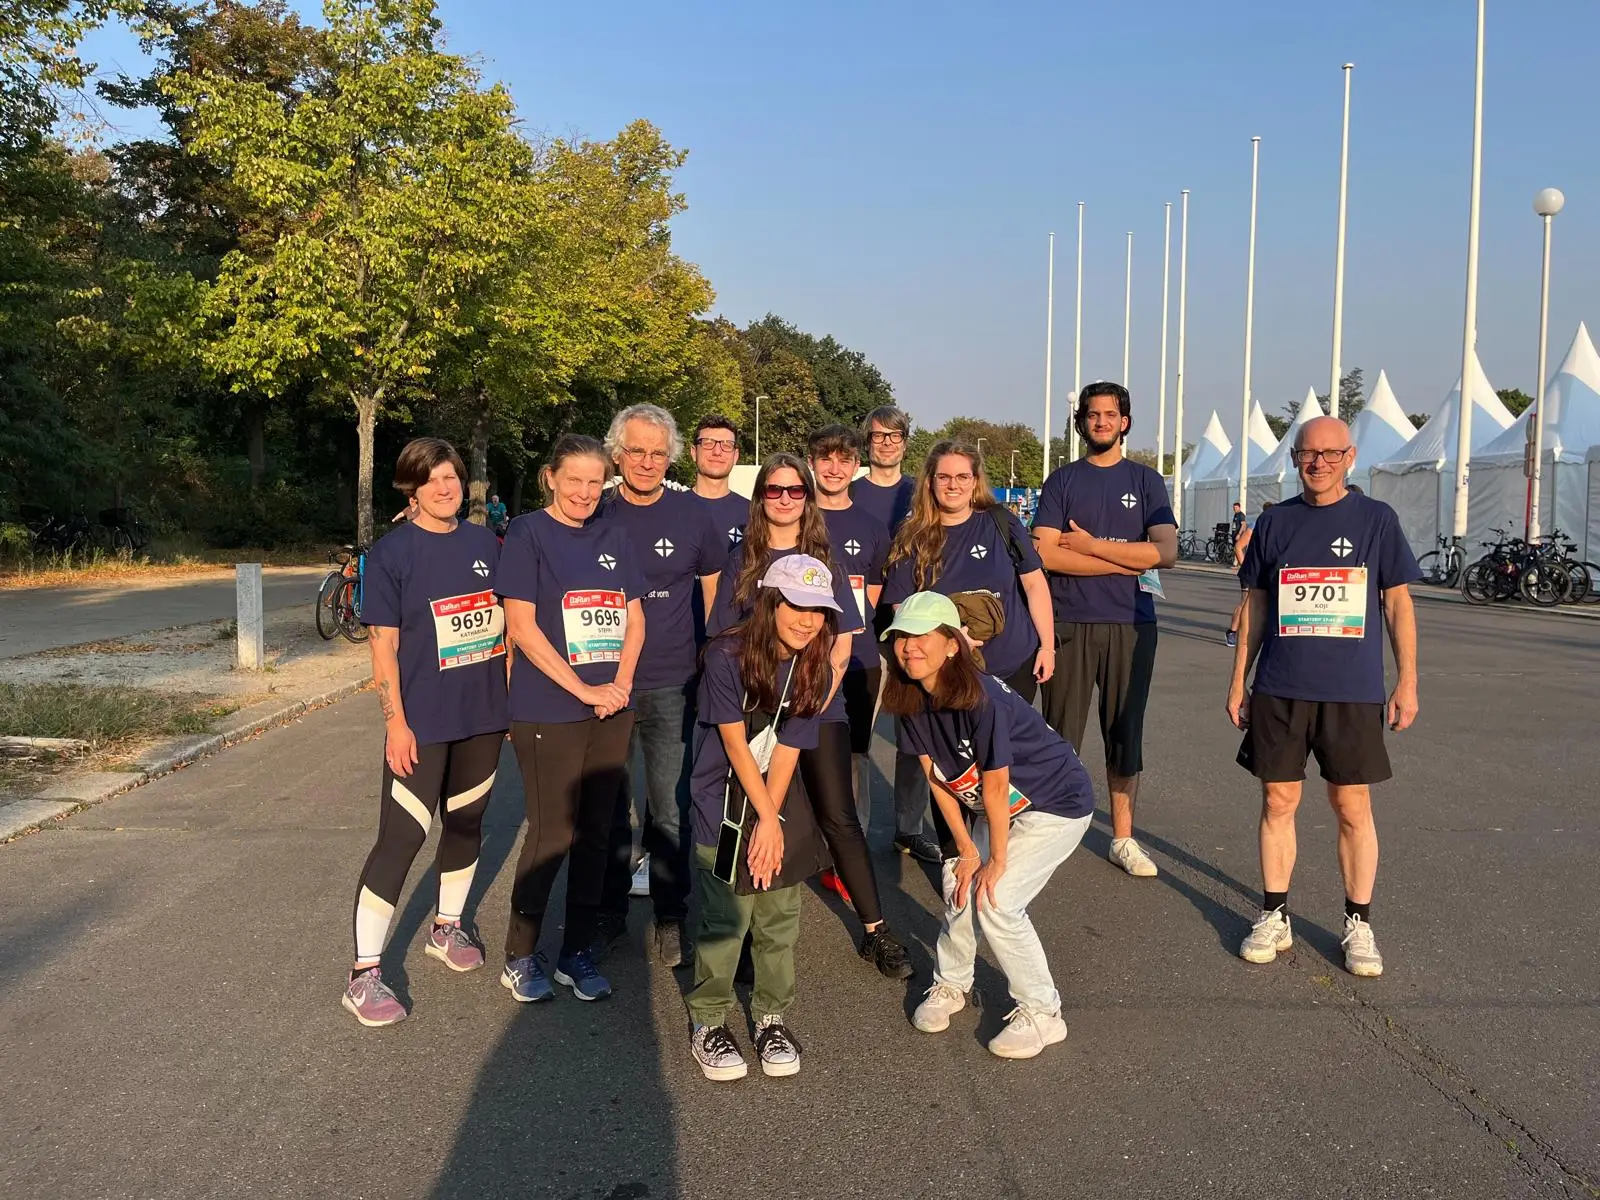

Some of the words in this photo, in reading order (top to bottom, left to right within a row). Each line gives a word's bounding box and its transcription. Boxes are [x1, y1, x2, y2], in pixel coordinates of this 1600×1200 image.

[1294, 585, 1349, 602] 9701
[450, 608, 493, 633] 9697
[580, 608, 621, 627] 9696
[460, 627, 489, 638] KATHARINA
